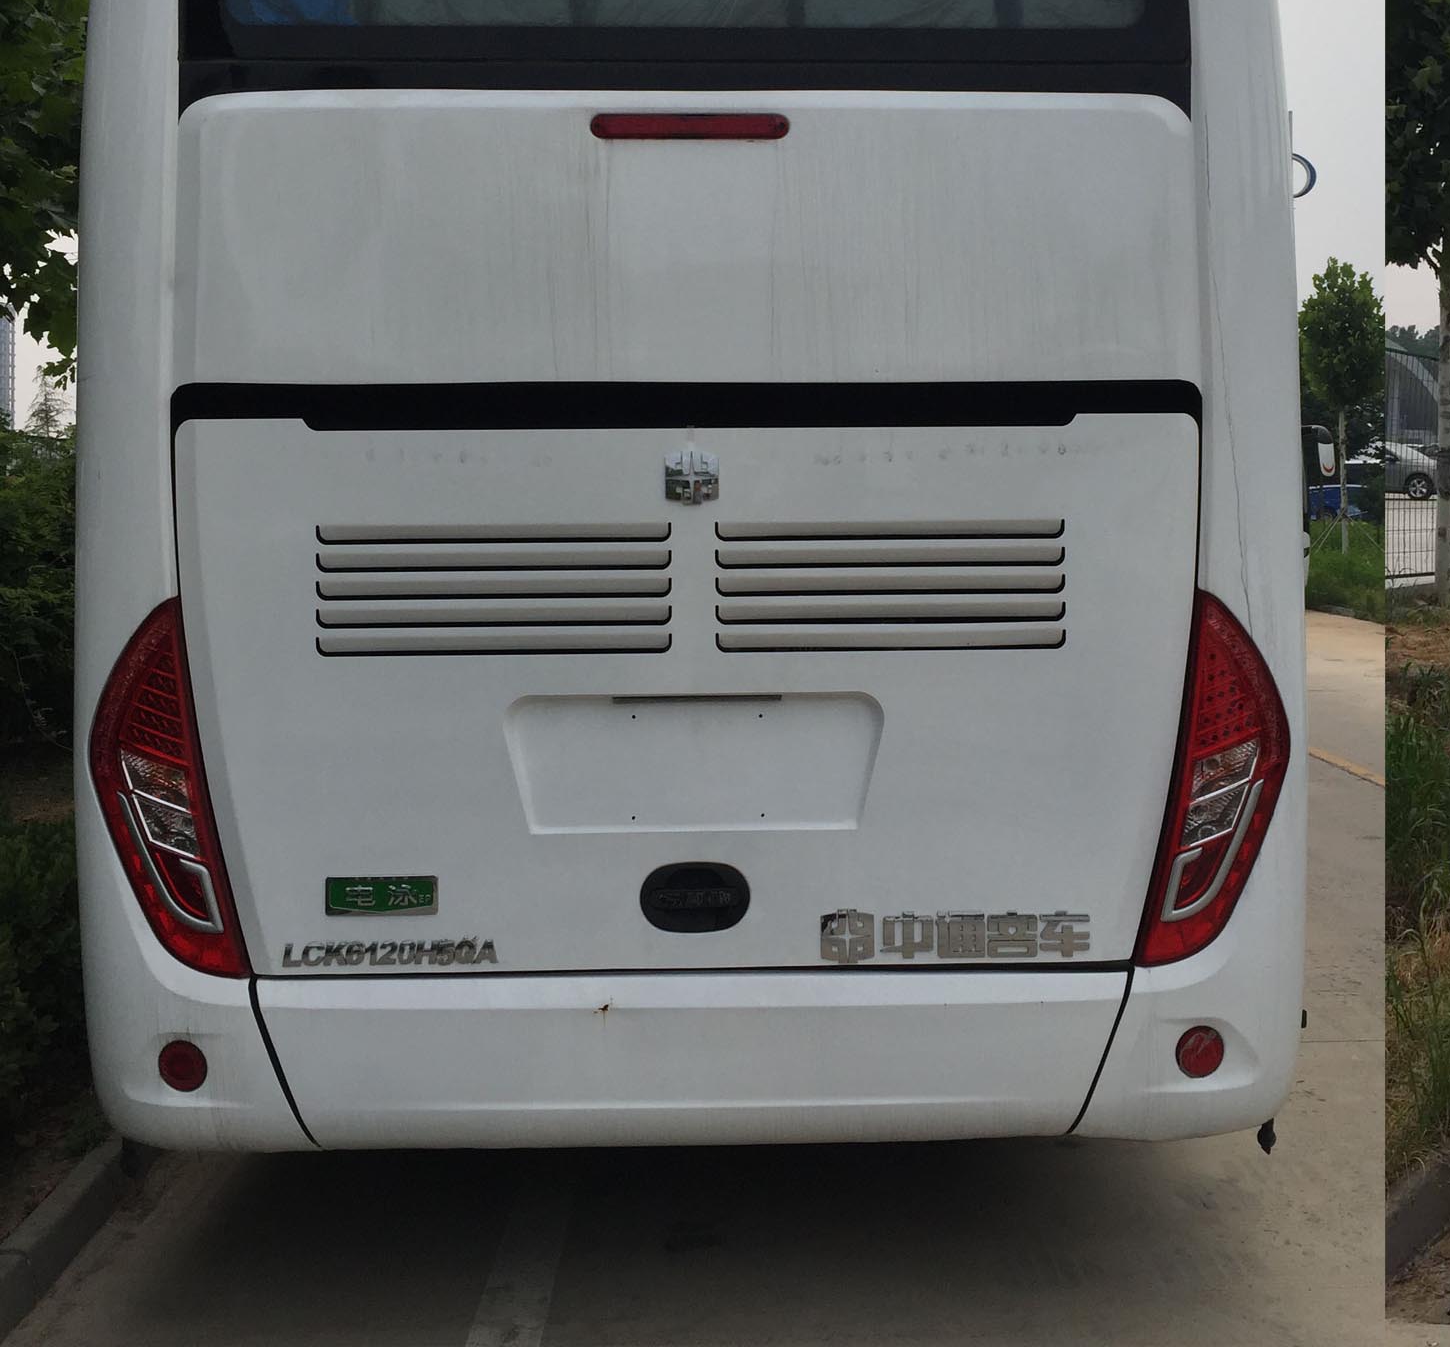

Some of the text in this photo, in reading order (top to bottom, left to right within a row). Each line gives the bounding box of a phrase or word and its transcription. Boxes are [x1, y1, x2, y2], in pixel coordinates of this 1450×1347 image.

[345, 884, 418, 906] 电泳
[879, 910, 1091, 959] 中通客车
